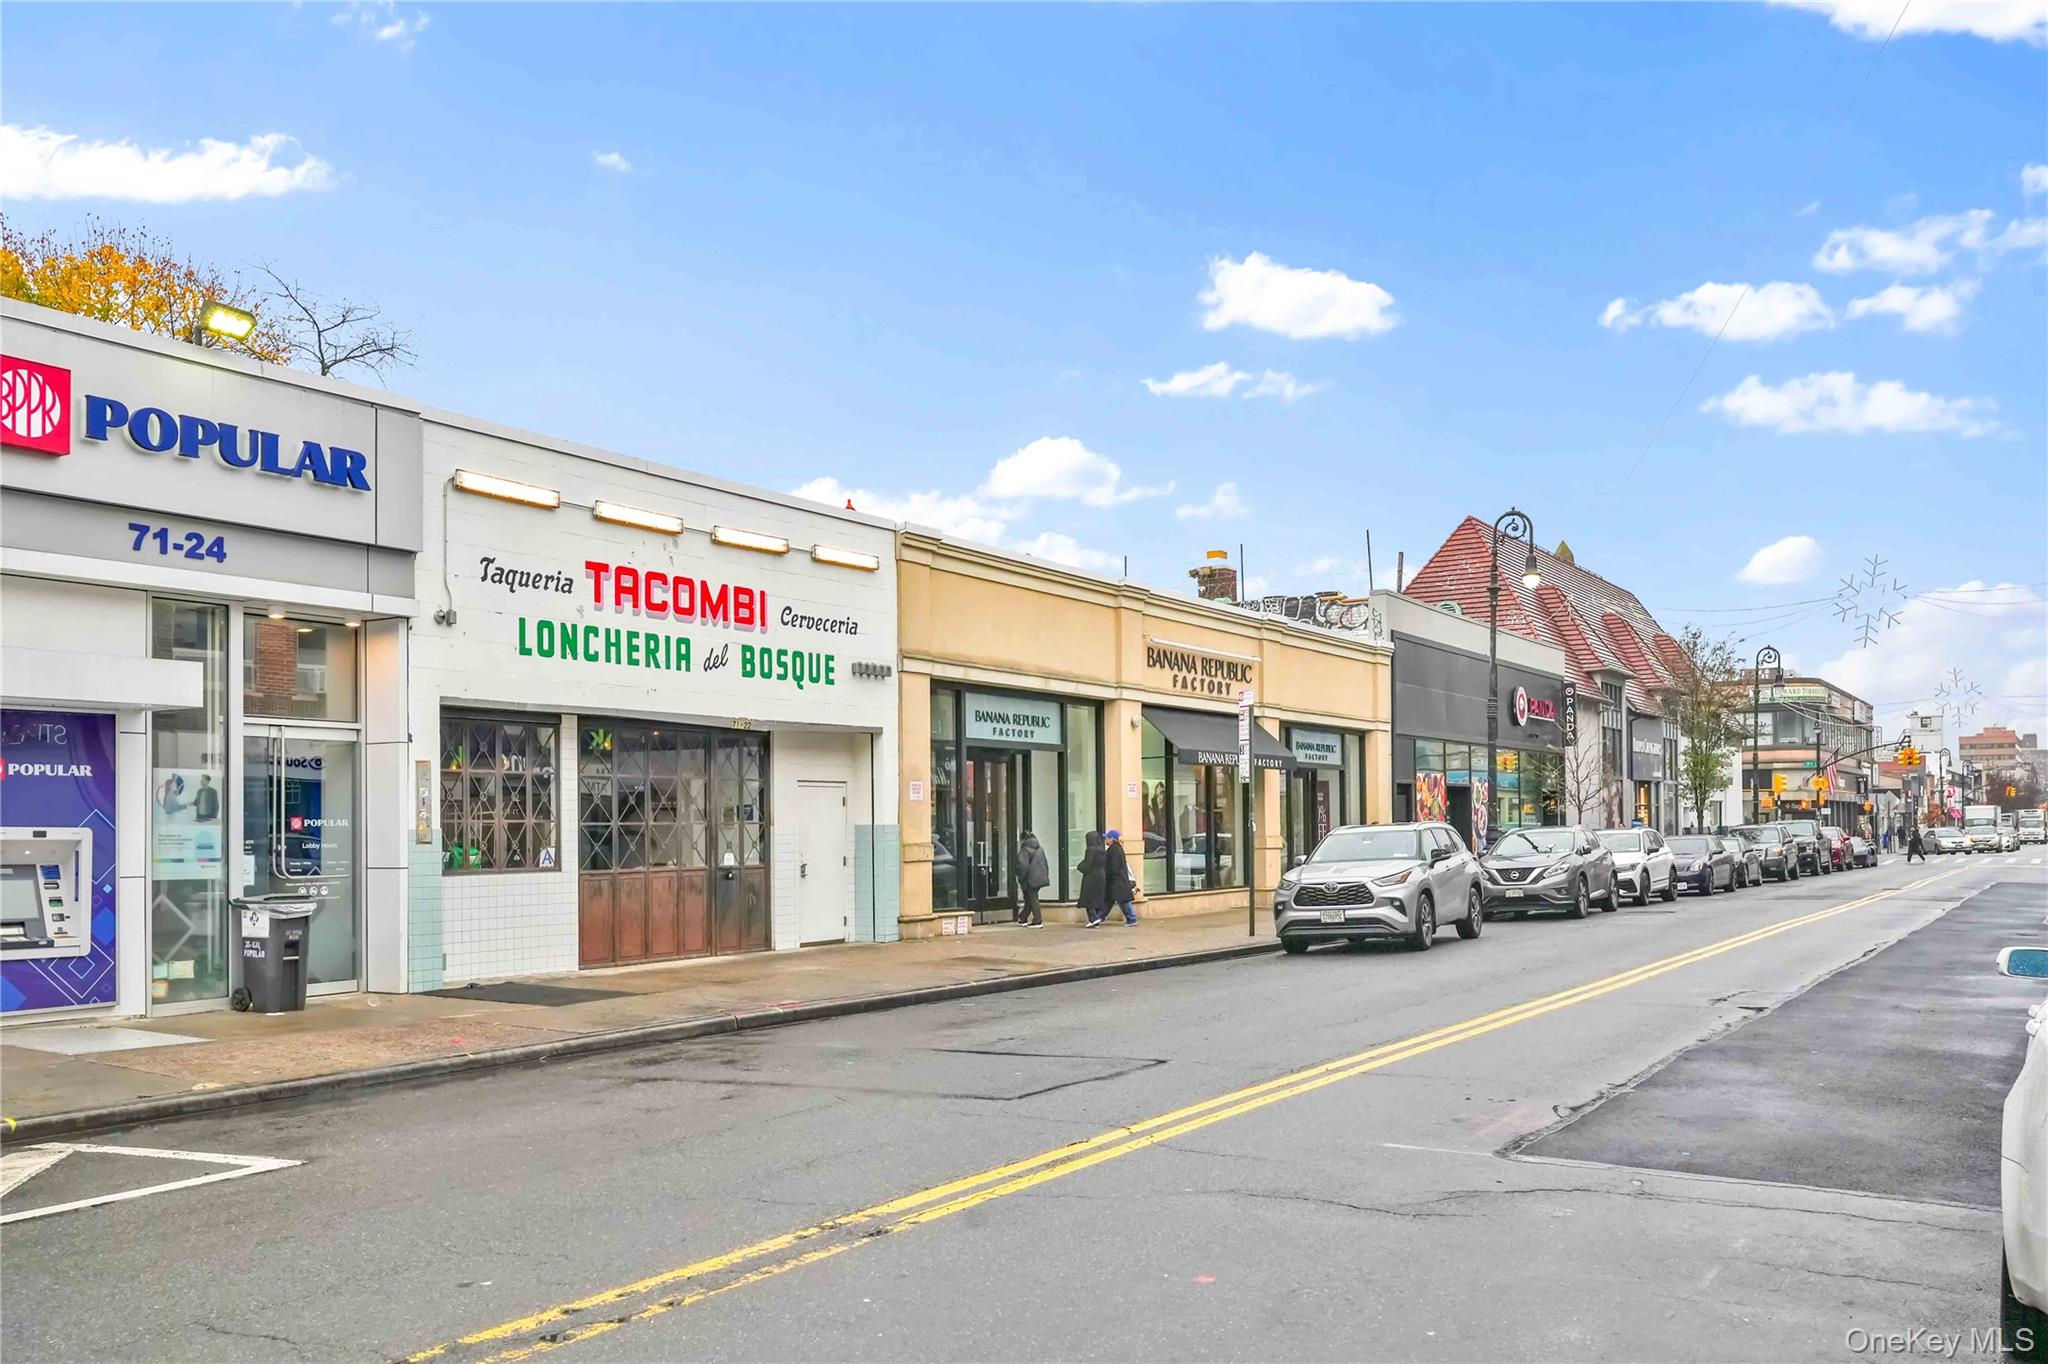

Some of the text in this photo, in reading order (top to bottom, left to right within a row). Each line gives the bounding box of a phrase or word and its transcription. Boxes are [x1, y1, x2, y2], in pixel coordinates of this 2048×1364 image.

[84, 394, 372, 492] POPULAR
[128, 522, 228, 564] 71-24
[479, 556, 860, 637] Taqueria TACOMBI Cerveceria
[518, 616, 836, 690] LONCHERIA del BOSQUE
[1146, 646, 1253, 684] BANANA REPUBLIC
[1172, 674, 1232, 696] FACTORY
[974, 709, 1051, 729] BANANA REPUBLIC
[1529, 697, 1557, 720] PANDA
[1565, 697, 1575, 740] PANDA
[992, 726, 1035, 739] FACTORY
[1198, 752, 1225, 765] BANANA
[1305, 753, 1328, 761] FACTORY
[8, 763, 93, 777] POPULAR
[304, 818, 349, 827] POPULAR
[302, 842, 320, 850] Lobby
[541, 849, 554, 865] A
